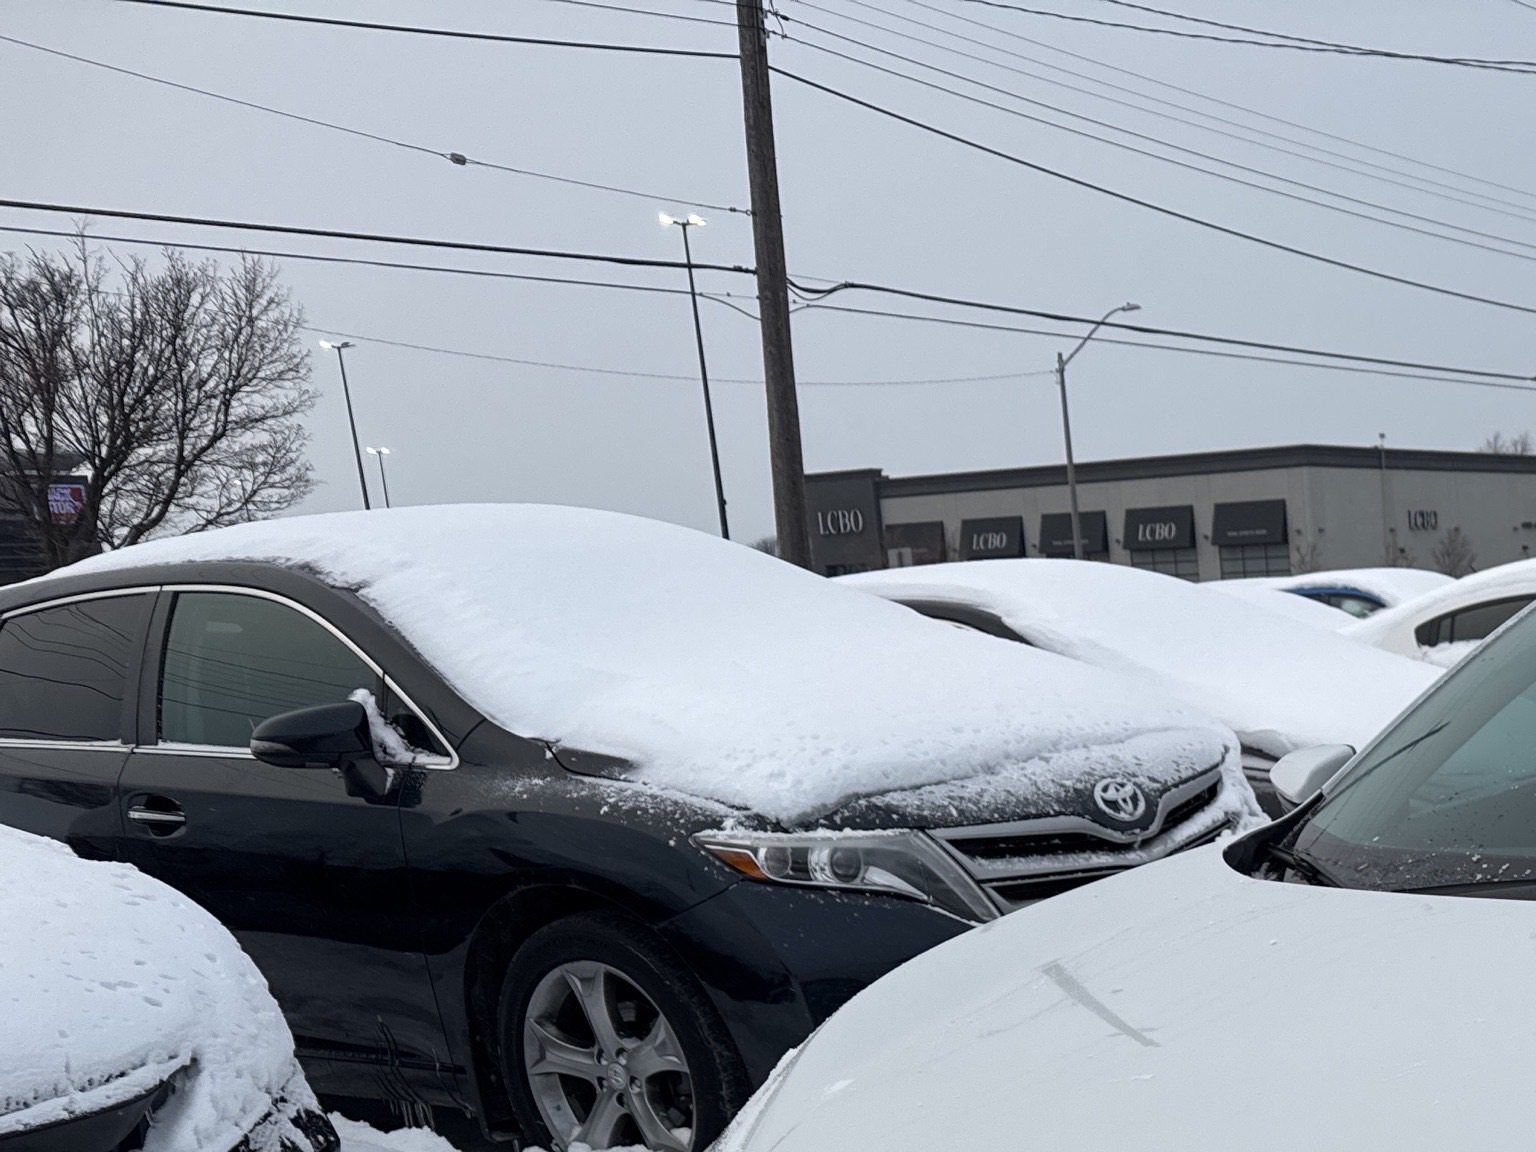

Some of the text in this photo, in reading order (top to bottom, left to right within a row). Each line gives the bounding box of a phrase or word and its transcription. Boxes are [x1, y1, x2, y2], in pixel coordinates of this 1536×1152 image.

[817, 508, 864, 535] LCBO
[1138, 521, 1176, 542] LCBO
[972, 531, 1007, 550] LCBO
